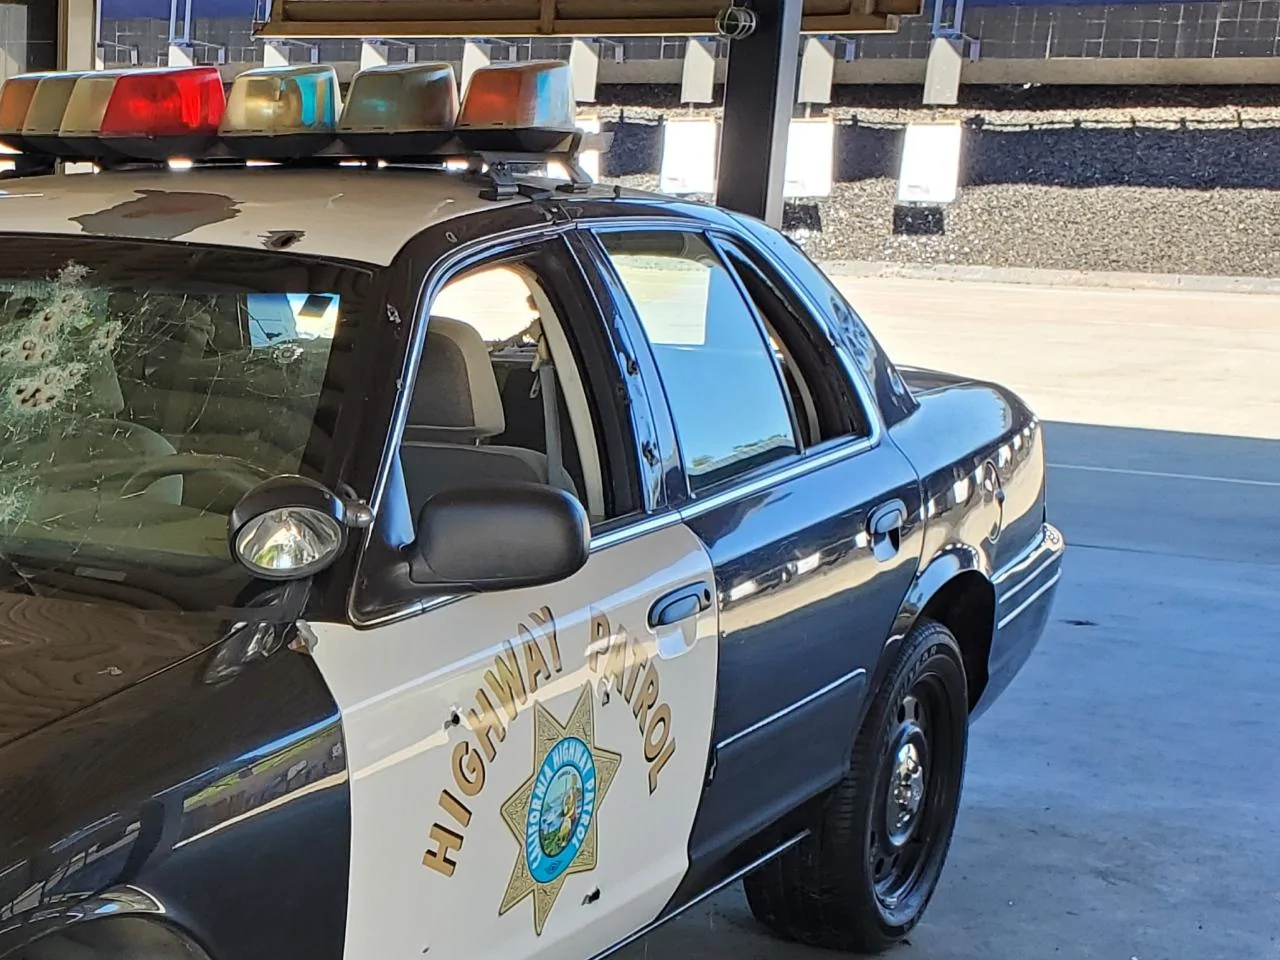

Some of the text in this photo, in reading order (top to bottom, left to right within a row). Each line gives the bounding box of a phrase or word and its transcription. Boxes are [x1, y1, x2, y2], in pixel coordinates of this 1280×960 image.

[422, 605, 562, 877] HIGHWAY
[587, 605, 676, 796] PATROL
[552, 741, 592, 777] HIGHWAY
[571, 778, 595, 848] PATROL
